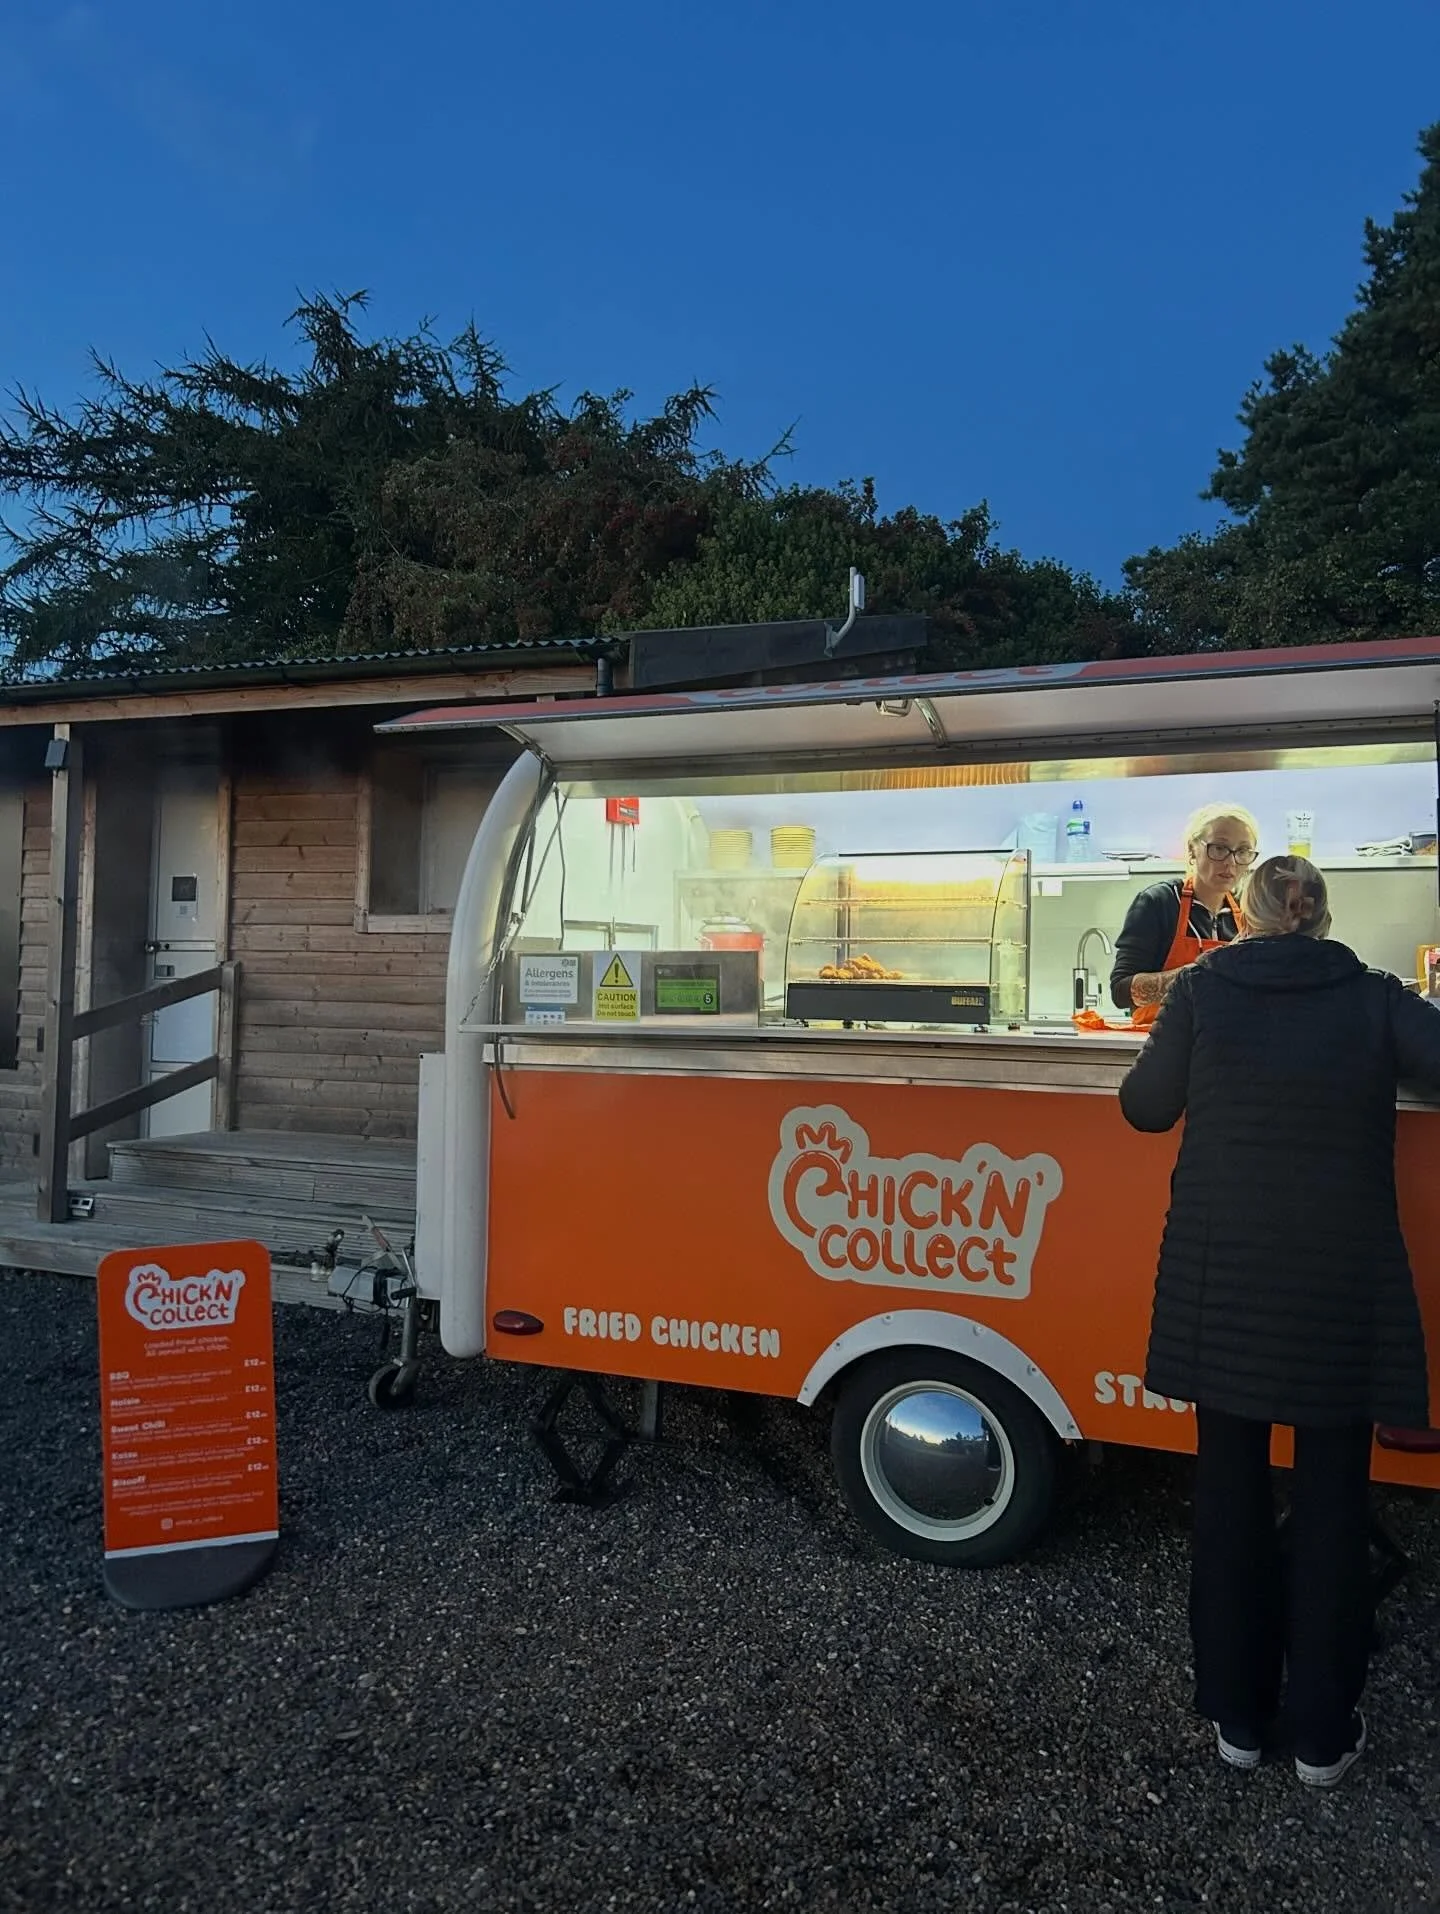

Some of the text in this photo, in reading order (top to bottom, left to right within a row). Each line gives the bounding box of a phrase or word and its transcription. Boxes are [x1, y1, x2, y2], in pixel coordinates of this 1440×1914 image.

[525, 968, 573, 981] Allergens
[597, 993, 636, 1001] CAUTION
[705, 994, 712, 1004] 5
[563, 1306, 781, 1359] FRIED CHICKEN
